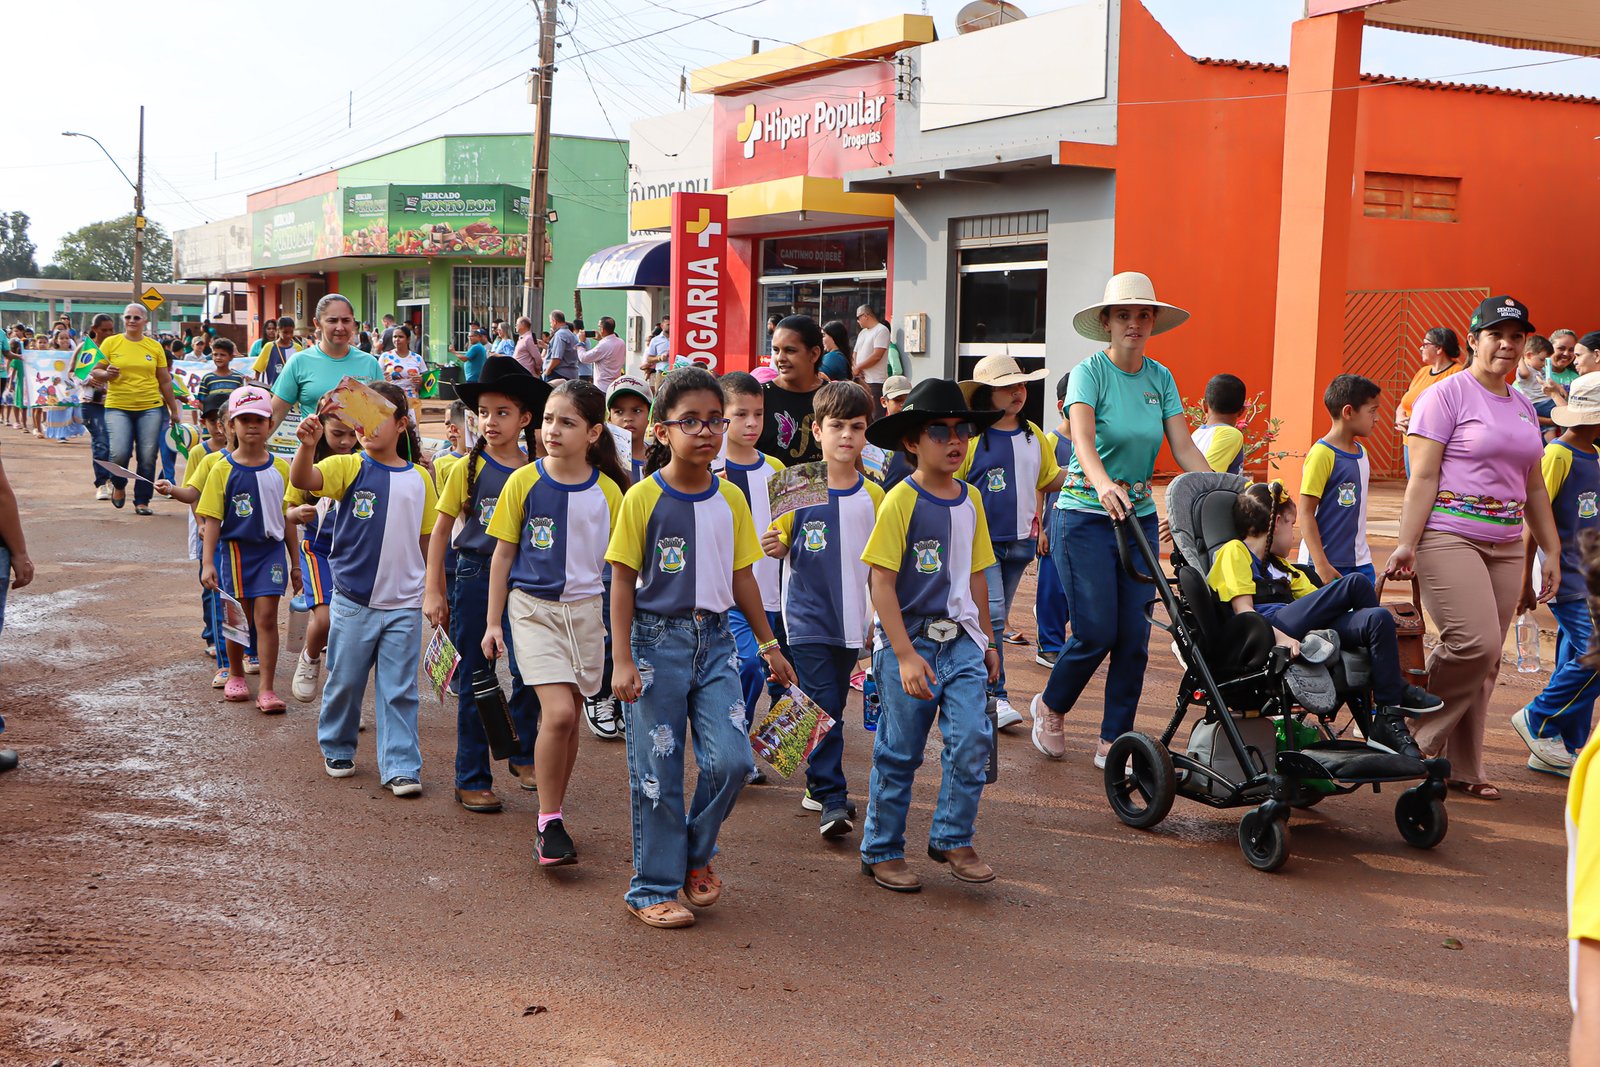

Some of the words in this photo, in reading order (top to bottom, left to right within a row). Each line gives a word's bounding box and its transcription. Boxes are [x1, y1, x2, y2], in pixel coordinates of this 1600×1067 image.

[764, 107, 811, 149] Hiper
[814, 91, 886, 137] Popular
[842, 129, 882, 150] Drogarias
[420, 199, 465, 213] PONTO
[465, 199, 496, 213] BOM
[780, 249, 814, 260] CANTINHO
[815, 250, 824, 260] DO
[686, 257, 719, 371] OGARIA
